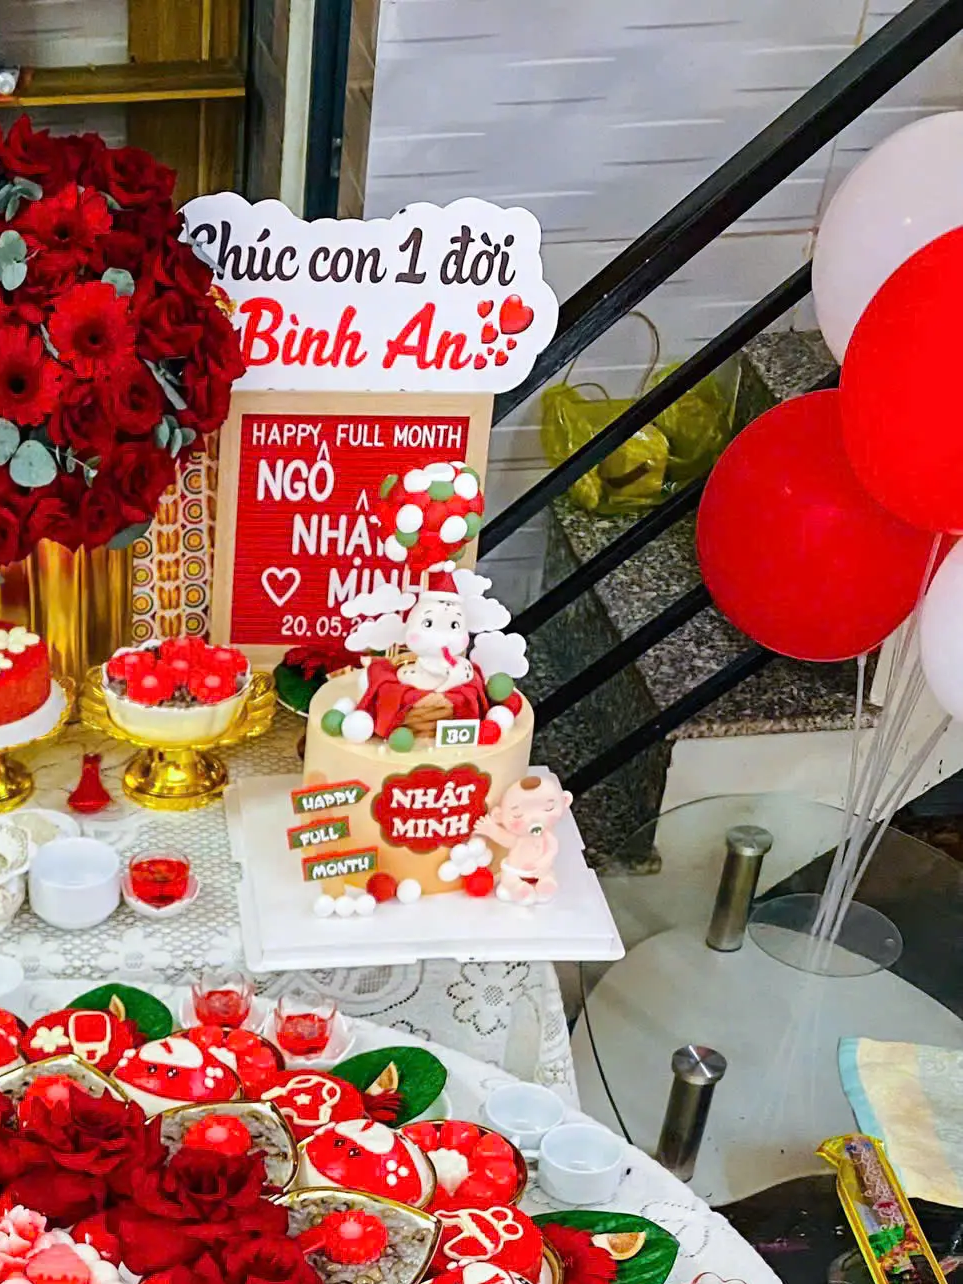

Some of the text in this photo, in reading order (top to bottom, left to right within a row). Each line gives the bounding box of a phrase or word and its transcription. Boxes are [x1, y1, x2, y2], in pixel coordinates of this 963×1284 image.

[308, 246, 387, 284] con
[395, 227, 427, 284] 1
[440, 224, 516, 286] đời
[240, 296, 473, 370] Bình An
[252, 422, 462, 448] HAPPY FULL MONTH
[256, 439, 335, 502] NGÔ
[301, 787, 358, 811] HAPPY
[390, 781, 476, 814] NHẬT
[299, 827, 340, 847] FULL
[392, 812, 470, 839] MINH
[312, 856, 370, 880] MONTH
